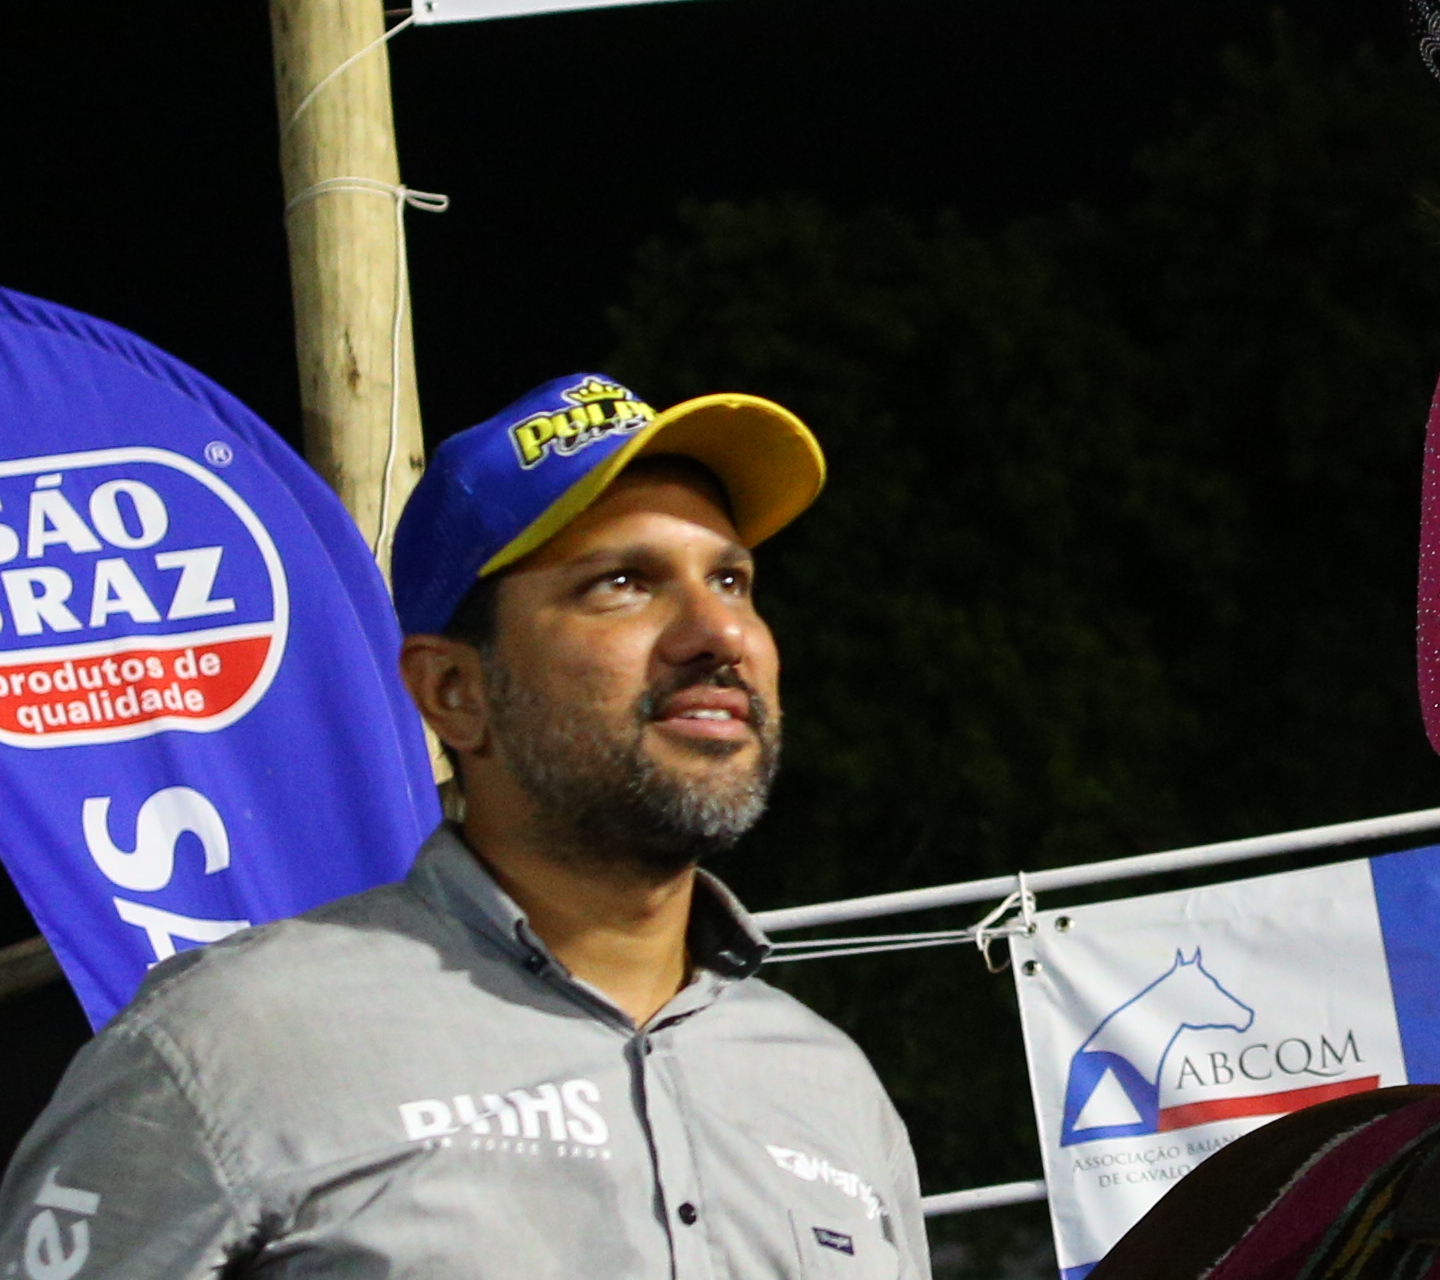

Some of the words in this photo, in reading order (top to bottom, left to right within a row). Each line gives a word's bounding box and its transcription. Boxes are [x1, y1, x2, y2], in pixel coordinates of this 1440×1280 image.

[173, 648, 221, 677] de
[17, 683, 205, 733] qualidade
[1175, 1029, 1364, 1090] ABCQM
[1073, 1146, 1181, 1173] ASSOCIAÇÃO
[1098, 1173, 1121, 1188] DE
